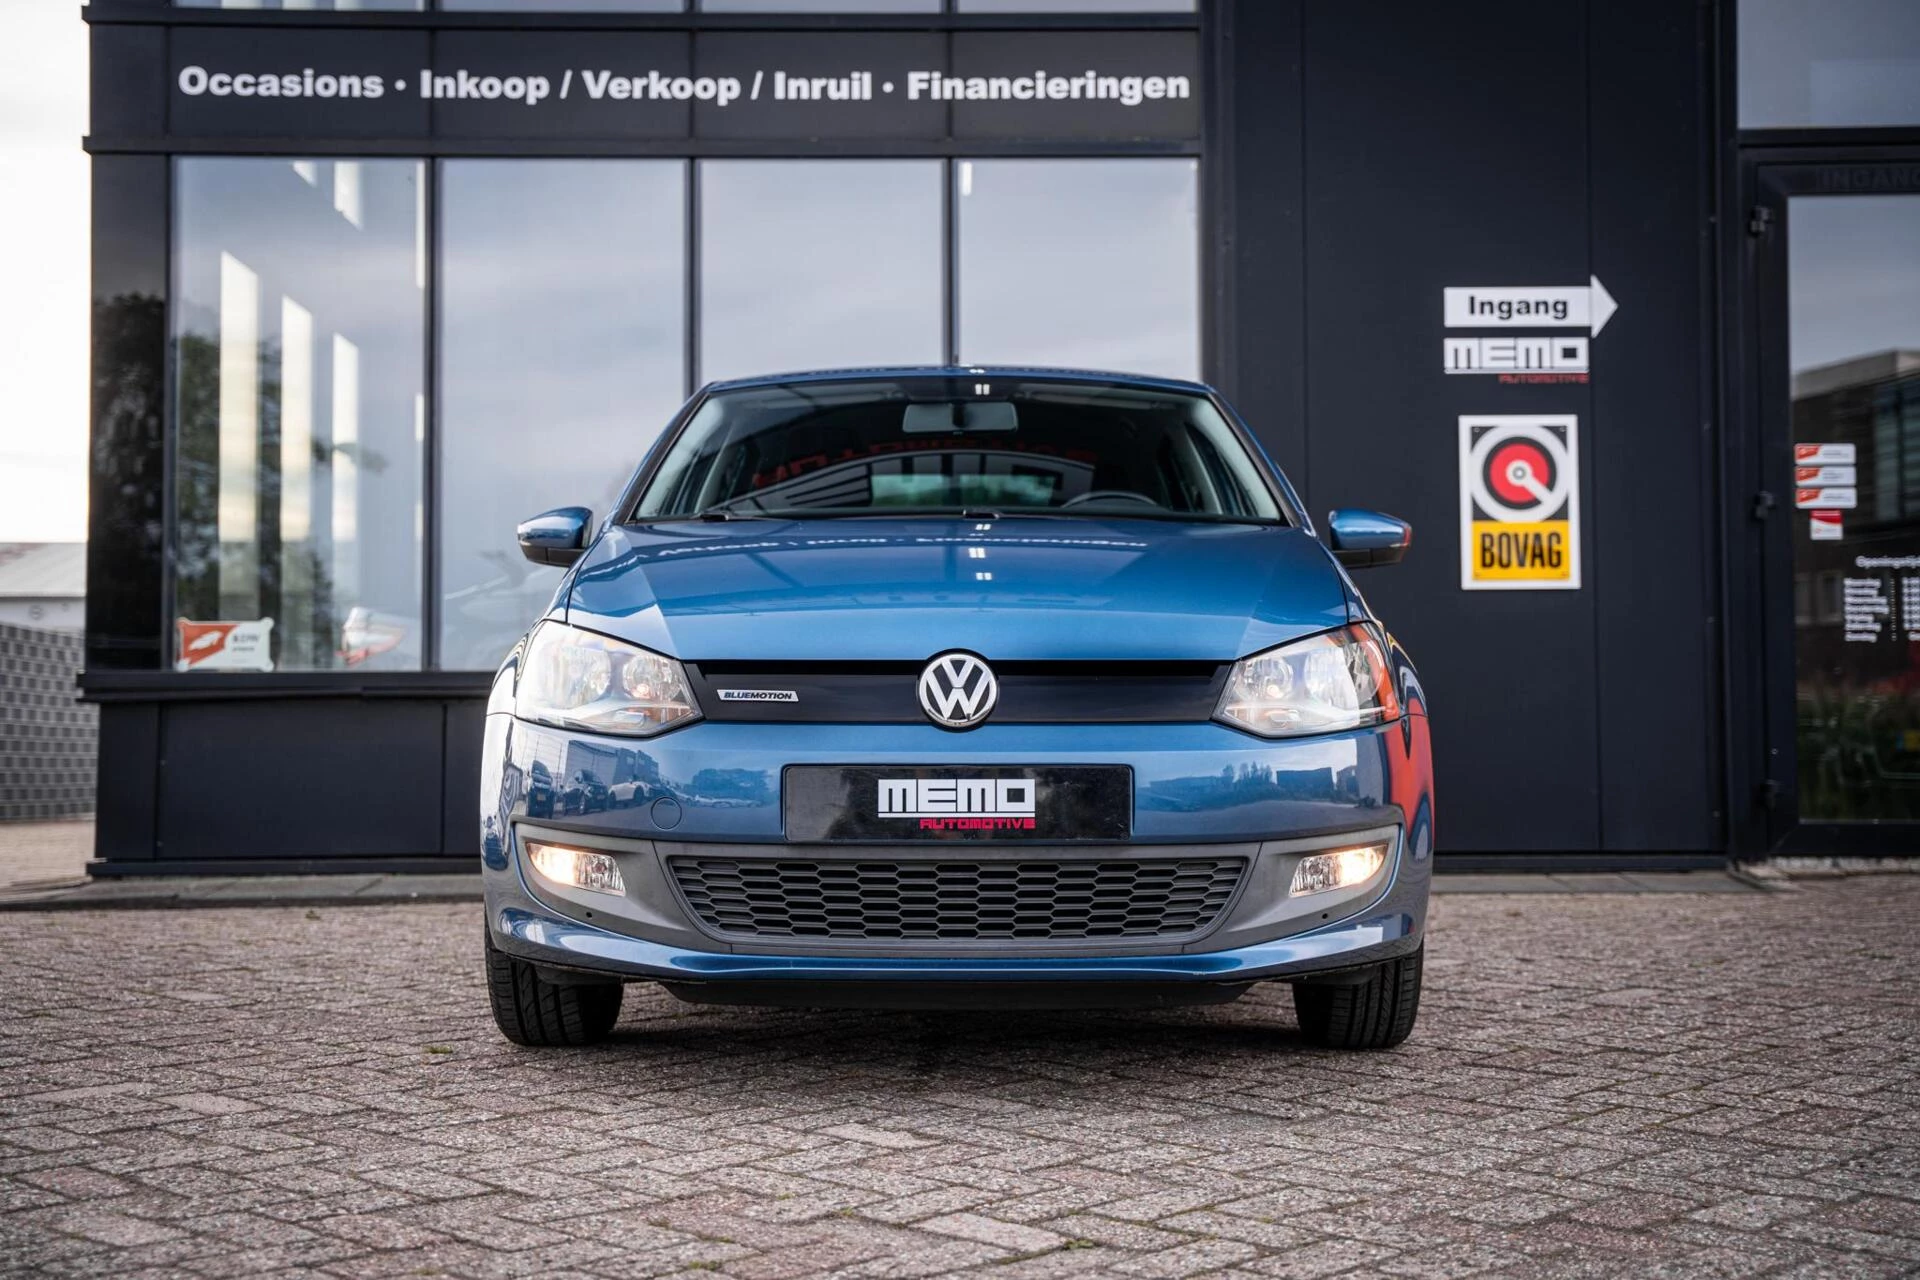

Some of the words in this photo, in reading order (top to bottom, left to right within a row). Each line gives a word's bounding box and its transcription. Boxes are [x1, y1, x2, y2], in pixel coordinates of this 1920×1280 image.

[178, 65, 385, 97] Occasions
[420, 69, 550, 106] Inkoop
[581, 69, 742, 106] Verkoop
[774, 70, 873, 101] Inruil
[907, 70, 1190, 106] Financieringen
[1468, 295, 1568, 321] Ingang
[1443, 336, 1589, 370] MEMO
[1480, 532, 1562, 569] BOVAG
[723, 691, 793, 700] BLUEMOTION
[877, 778, 1036, 813] MEMO
[919, 817, 1036, 830] AUTOMOTIVE
